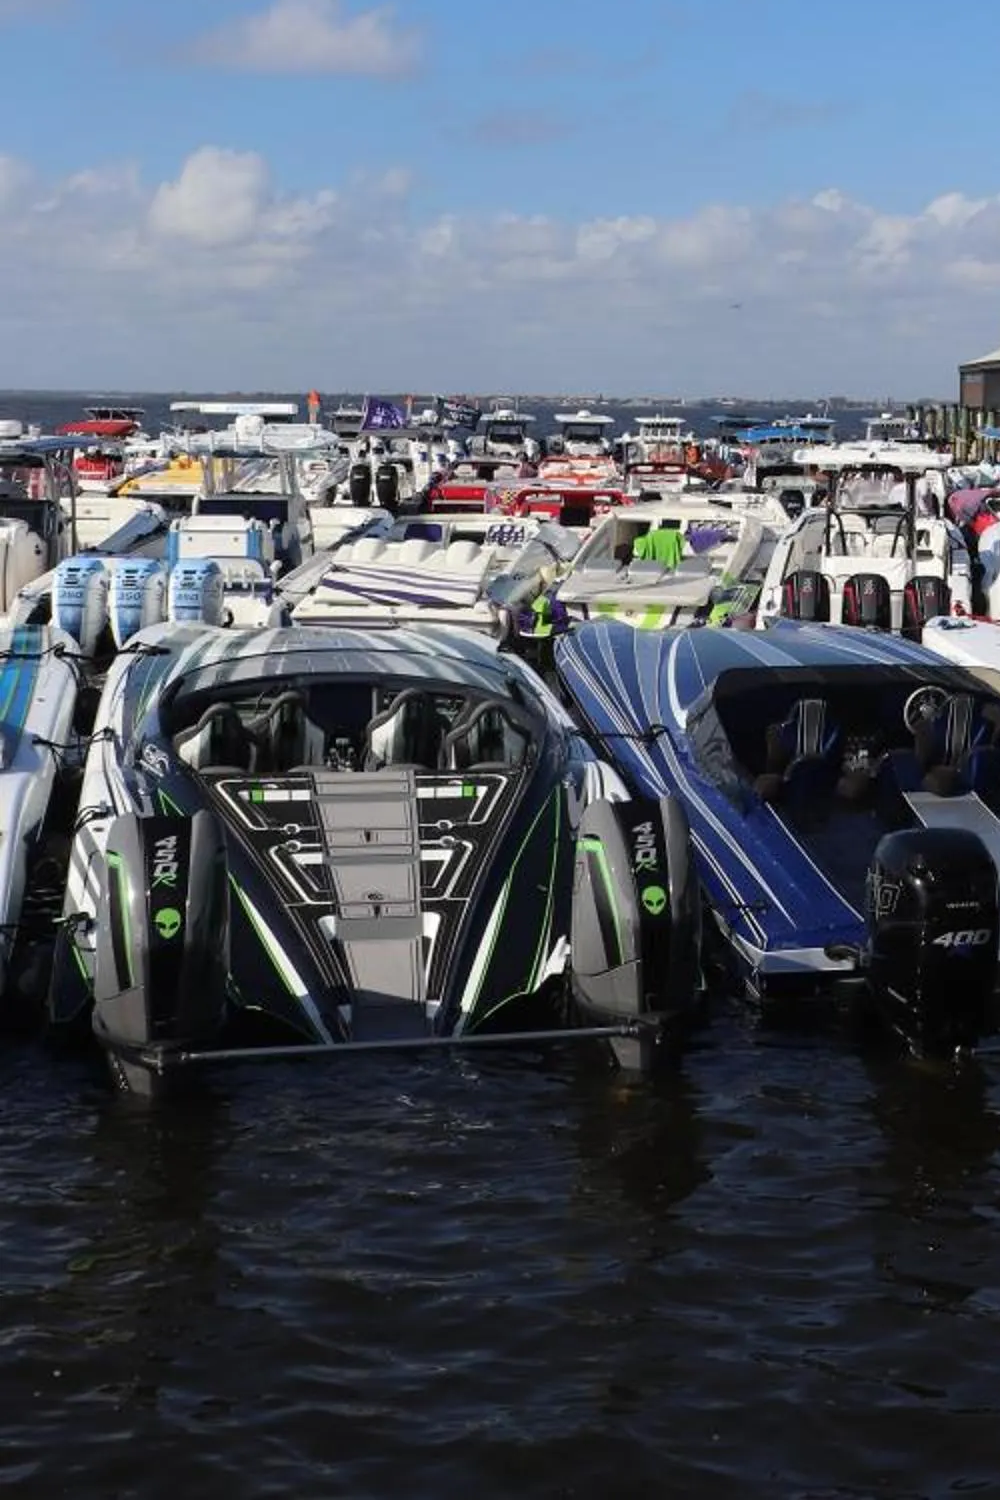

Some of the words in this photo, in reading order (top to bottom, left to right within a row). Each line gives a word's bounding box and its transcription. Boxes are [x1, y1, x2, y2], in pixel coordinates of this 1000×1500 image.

[151, 835, 178, 888] 450R
[631, 821, 658, 875] 450R
[932, 929, 992, 948] 400
